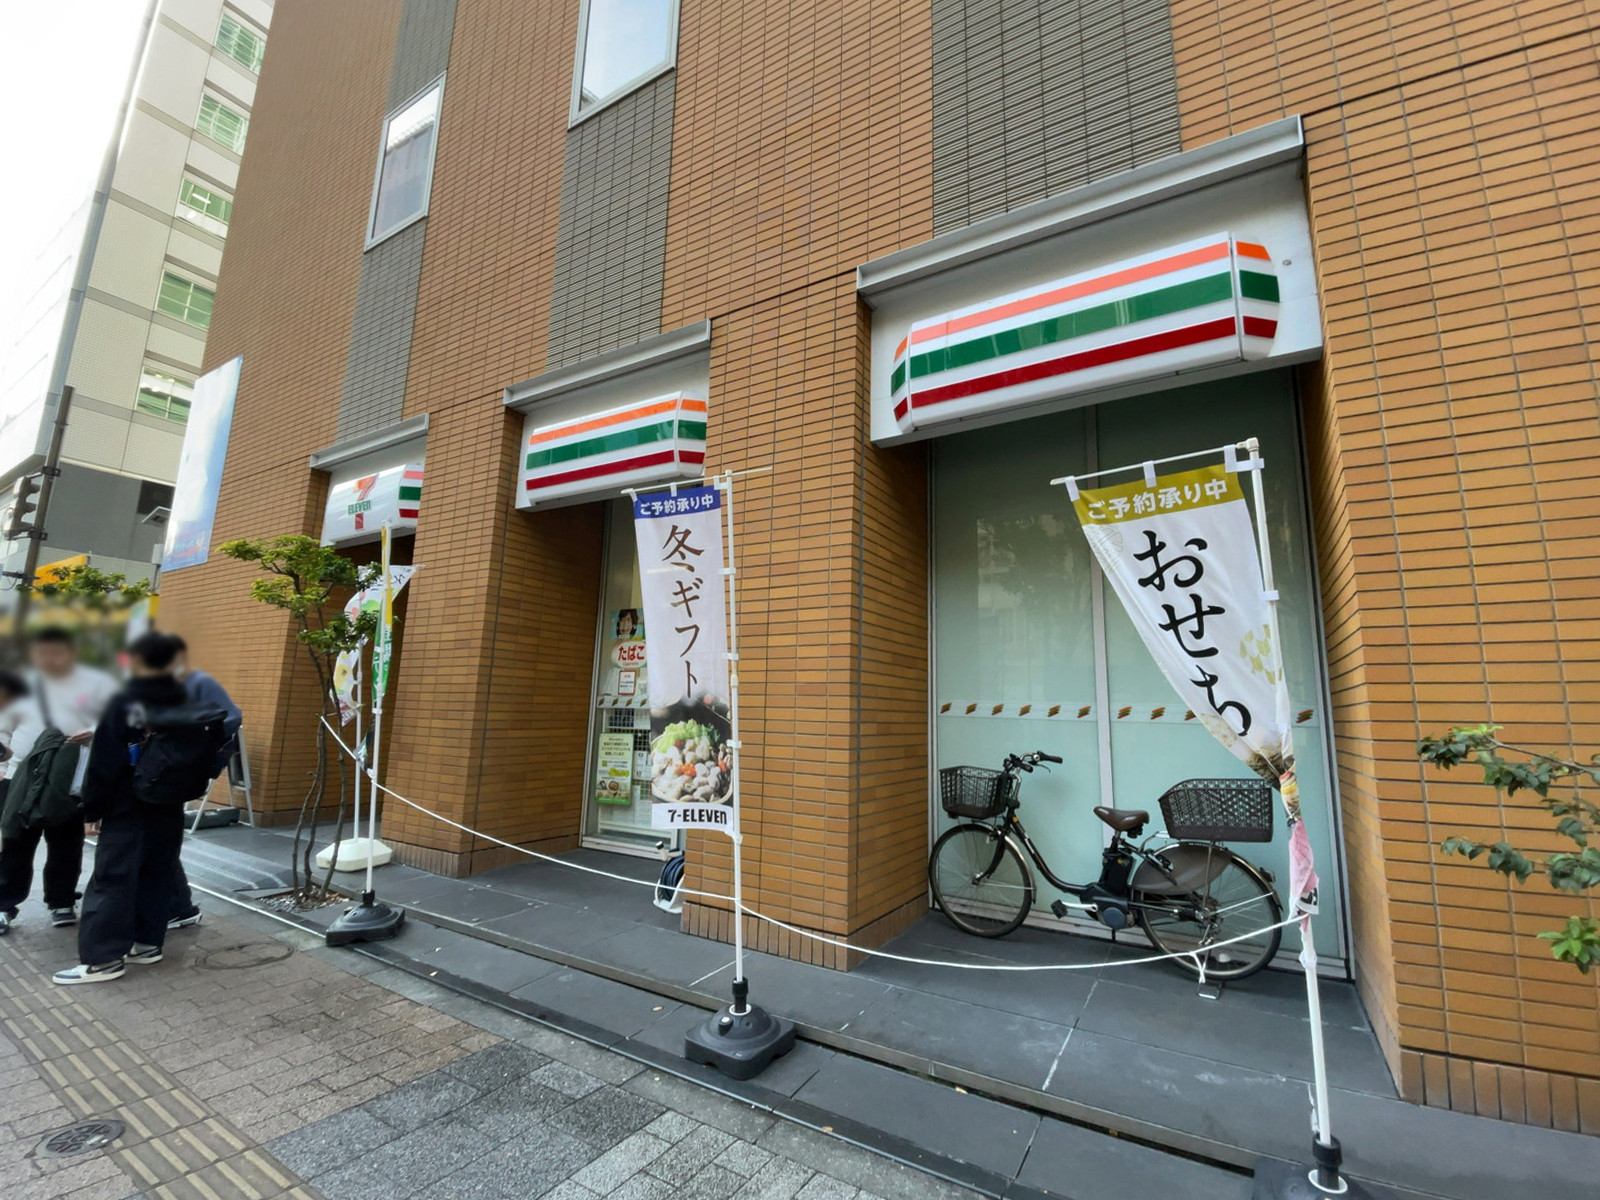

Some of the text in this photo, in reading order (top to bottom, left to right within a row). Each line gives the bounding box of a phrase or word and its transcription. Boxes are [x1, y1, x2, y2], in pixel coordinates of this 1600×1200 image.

[640, 494, 714, 515] ご予約承り中
[1088, 479, 1228, 519] ご予約承り中
[661, 524, 705, 698] 冬ギフト
[1133, 529, 1252, 737] おせち
[617, 646, 645, 661] たばこ
